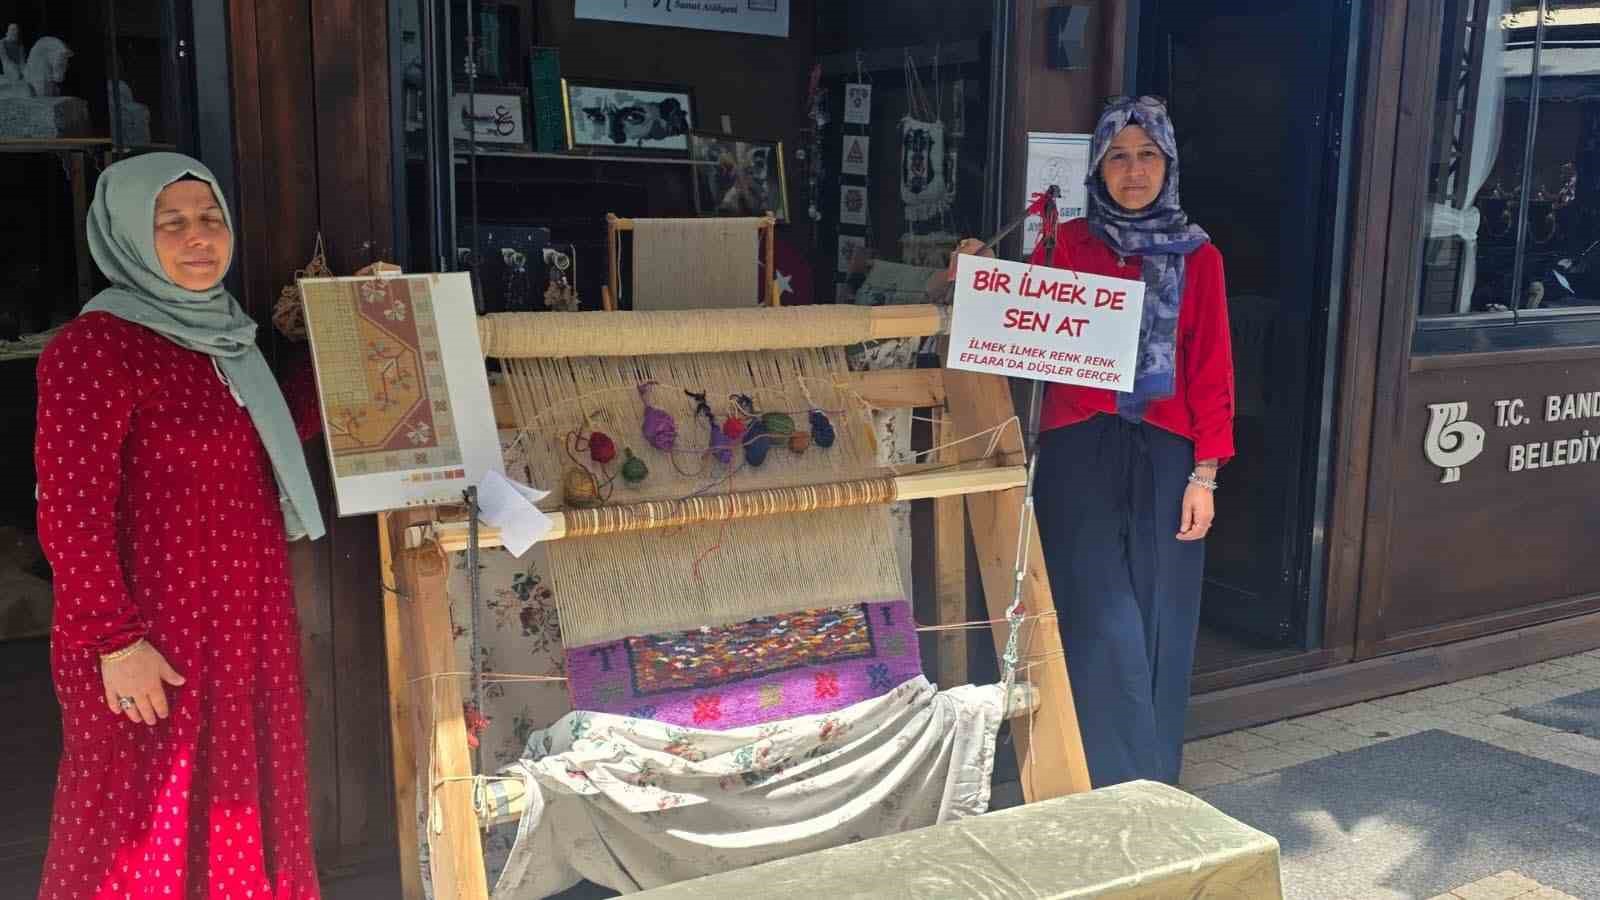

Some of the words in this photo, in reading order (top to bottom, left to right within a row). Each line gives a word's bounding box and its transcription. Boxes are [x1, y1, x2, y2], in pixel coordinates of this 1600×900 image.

[973, 268, 1011, 293] BİR
[1019, 272, 1086, 304] İLMEK
[1095, 289, 1126, 310] DE
[1003, 309, 1050, 332] SEN
[1056, 317, 1090, 338] AT
[968, 337, 1007, 354] İLMEK
[1048, 351, 1082, 364] RENK
[1083, 355, 1116, 368] RENK
[959, 353, 1024, 370] EFLARA'DA
[1027, 361, 1073, 377] DÜŞLER
[1076, 369, 1122, 383] GERÇEK
[1494, 399, 1530, 426] T.C.
